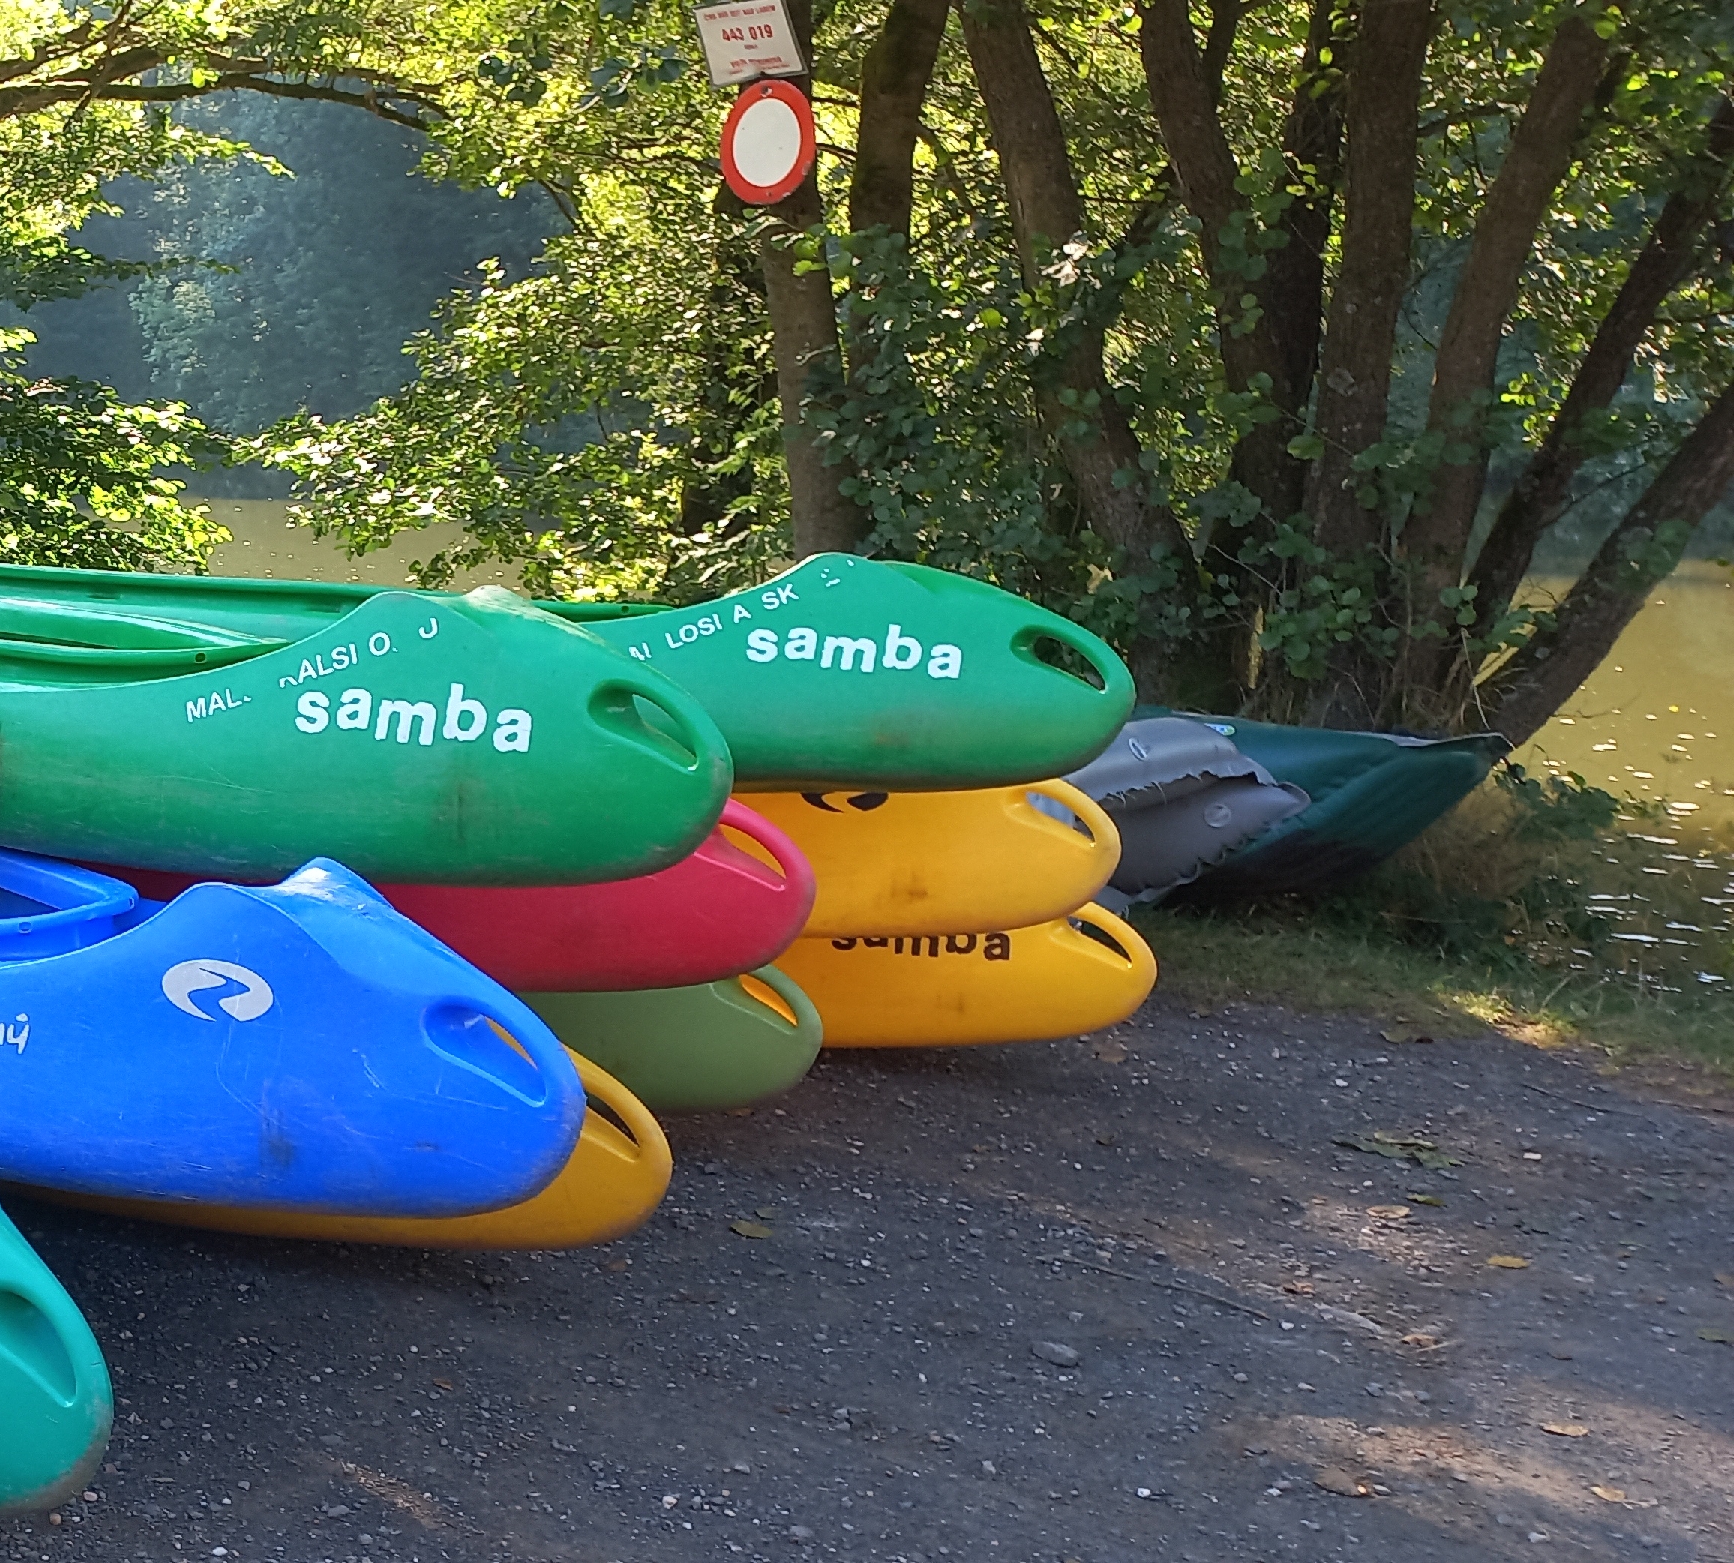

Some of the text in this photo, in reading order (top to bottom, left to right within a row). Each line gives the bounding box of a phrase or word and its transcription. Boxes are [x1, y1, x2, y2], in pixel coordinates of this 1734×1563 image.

[748, 23, 773, 40] 019
[664, 613, 724, 649] LOSI
[732, 604, 752, 624] A
[744, 624, 963, 679] samba
[294, 683, 532, 753] samba
